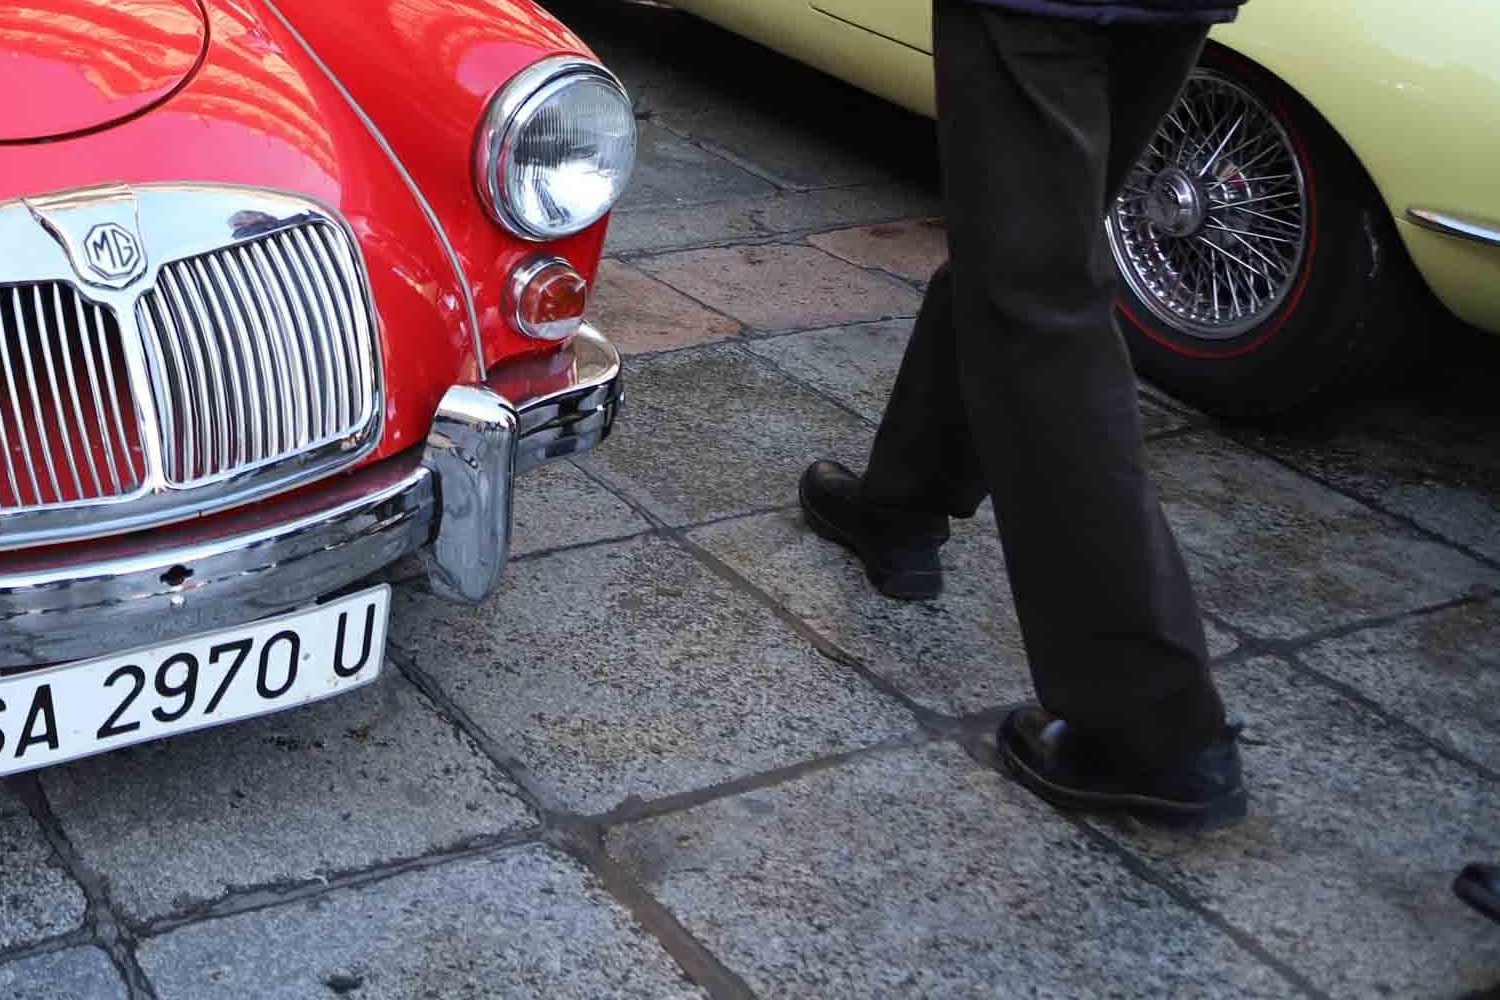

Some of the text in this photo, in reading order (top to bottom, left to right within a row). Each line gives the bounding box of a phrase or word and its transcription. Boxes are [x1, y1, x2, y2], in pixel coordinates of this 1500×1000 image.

[92, 229, 134, 269] MG
[96, 629, 301, 740] 2970
[332, 603, 376, 678] U
